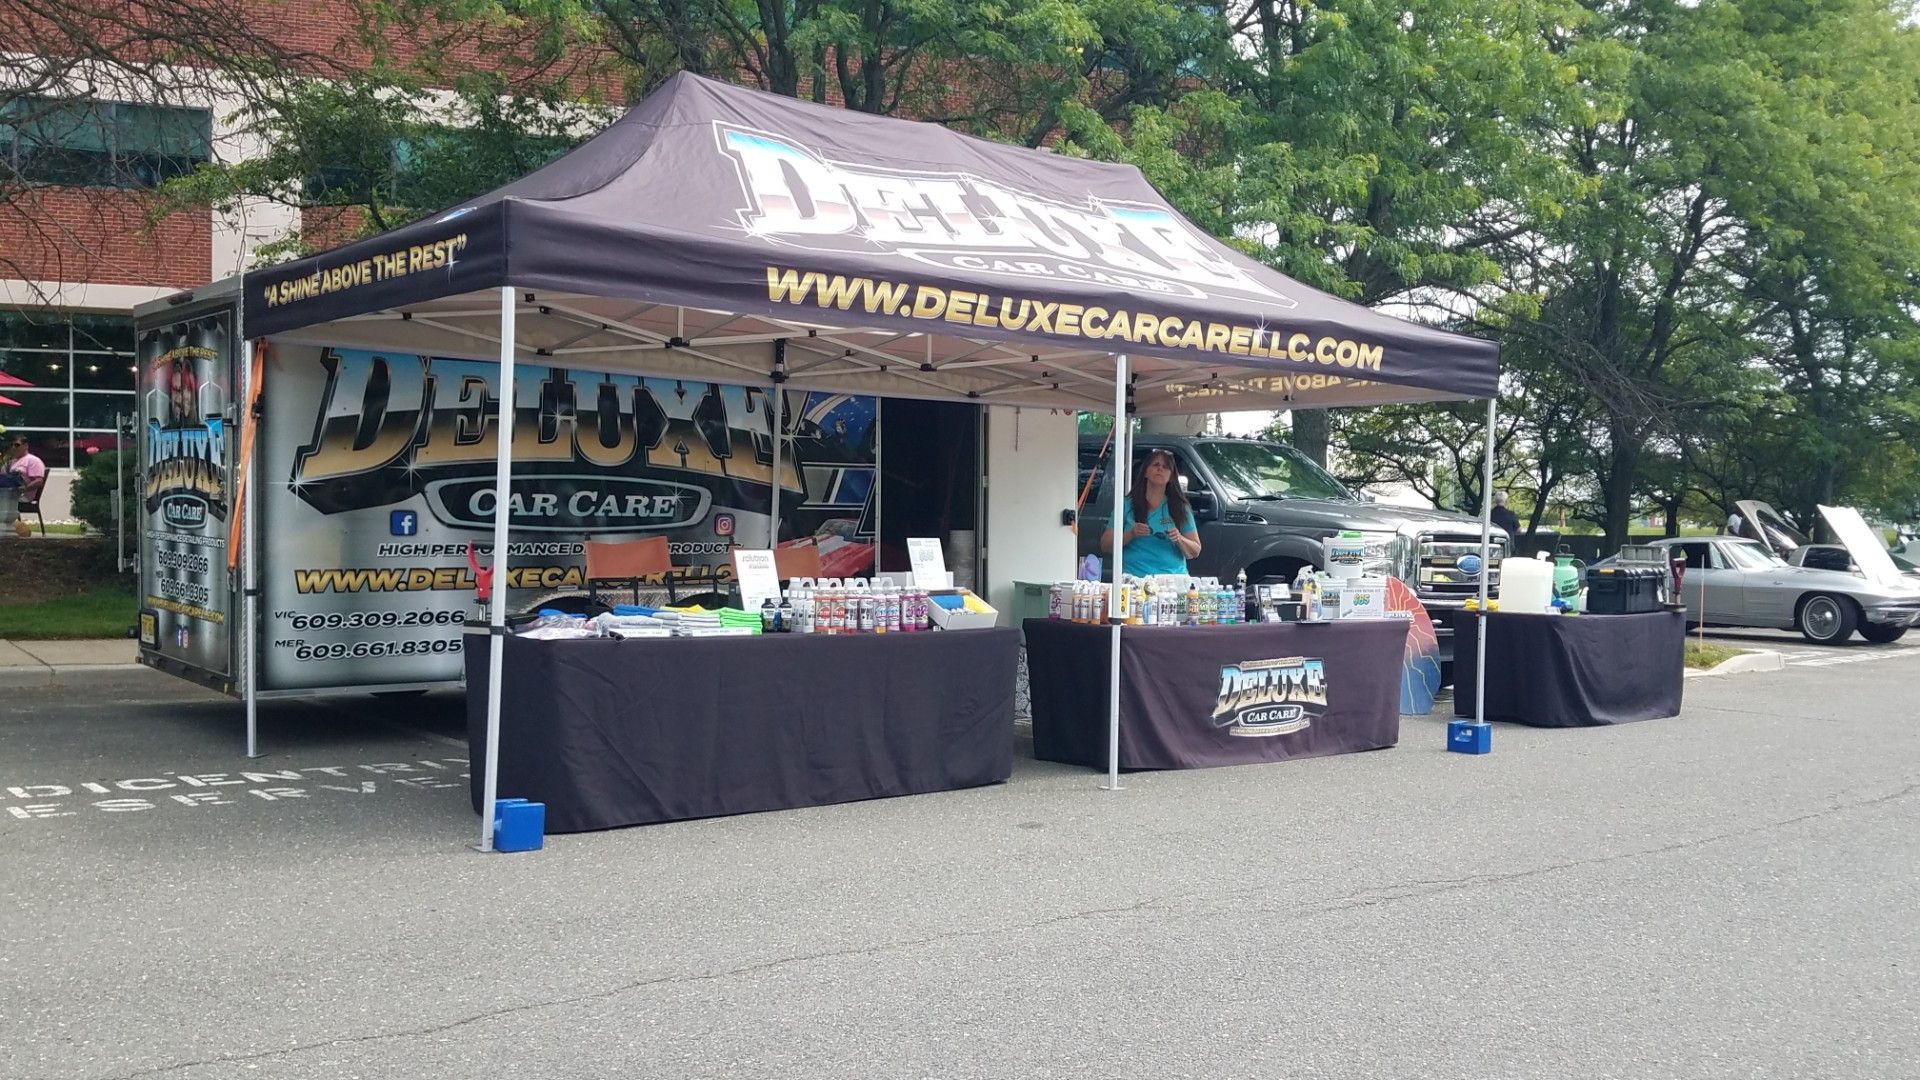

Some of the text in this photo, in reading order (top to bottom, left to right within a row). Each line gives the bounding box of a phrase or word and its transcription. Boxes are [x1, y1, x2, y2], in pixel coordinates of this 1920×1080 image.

[718, 124, 1296, 302] DELUXE
[279, 273, 320, 305] SHINE
[321, 260, 371, 294] ABOVE
[374, 251, 407, 281] THE
[953, 256, 1178, 292] CAR CARE
[766, 267, 1383, 371] WWW.DELUXECARCARELLC.COM
[300, 346, 805, 494] DELUXE
[167, 502, 203, 520] CAR CARE
[469, 488, 676, 518] CAR CARE
[377, 543, 430, 557] HIGH
[274, 609, 466, 630] VIC 609.309.2066
[274, 638, 464, 660] MER 609.661.8305
[1213, 660, 1328, 716] DELUXE
[1247, 709, 1297, 723] CAR CARE
